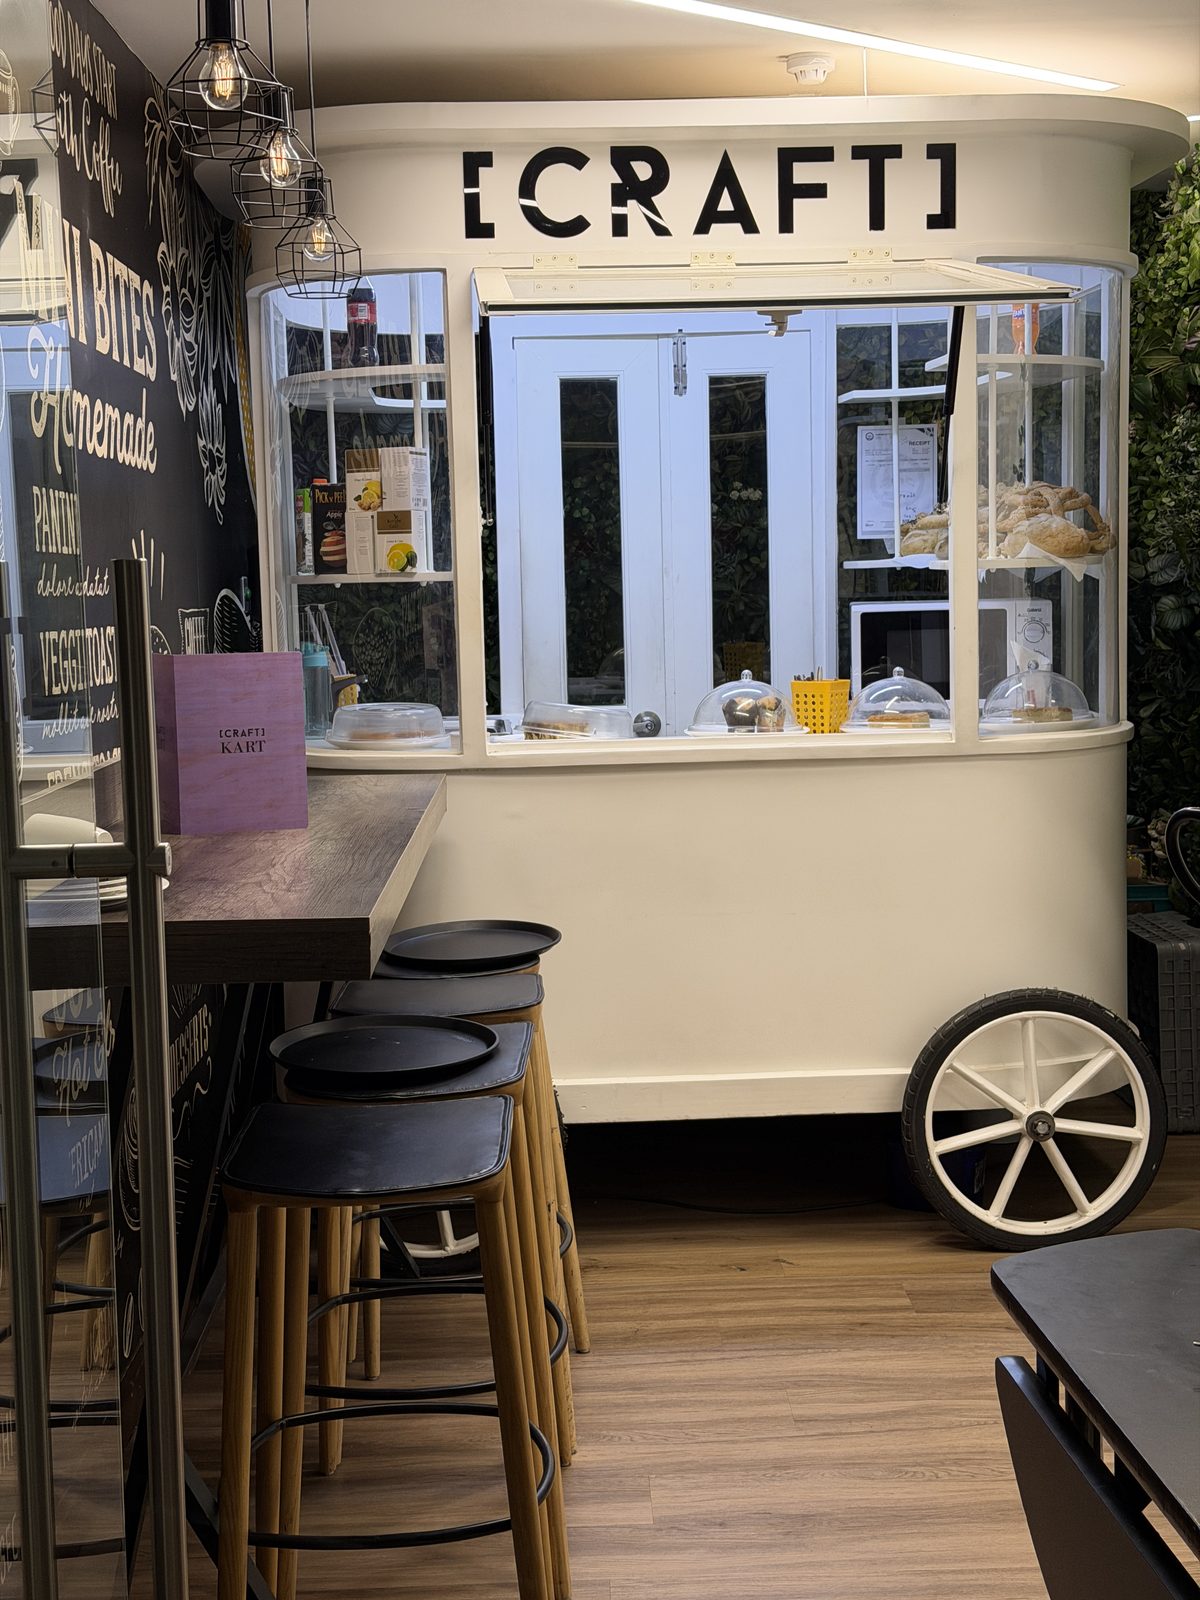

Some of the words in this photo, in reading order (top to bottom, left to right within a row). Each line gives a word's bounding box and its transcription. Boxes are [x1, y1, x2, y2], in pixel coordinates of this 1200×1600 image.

[49, 0, 67, 69] OOD
[67, 10, 94, 97] DAYS
[93, 41, 118, 120] START
[82, 97, 123, 218] Coffee
[89, 238, 157, 382] BITES
[27, 326, 158, 475] Homemade
[220, 740, 266, 754] KART
